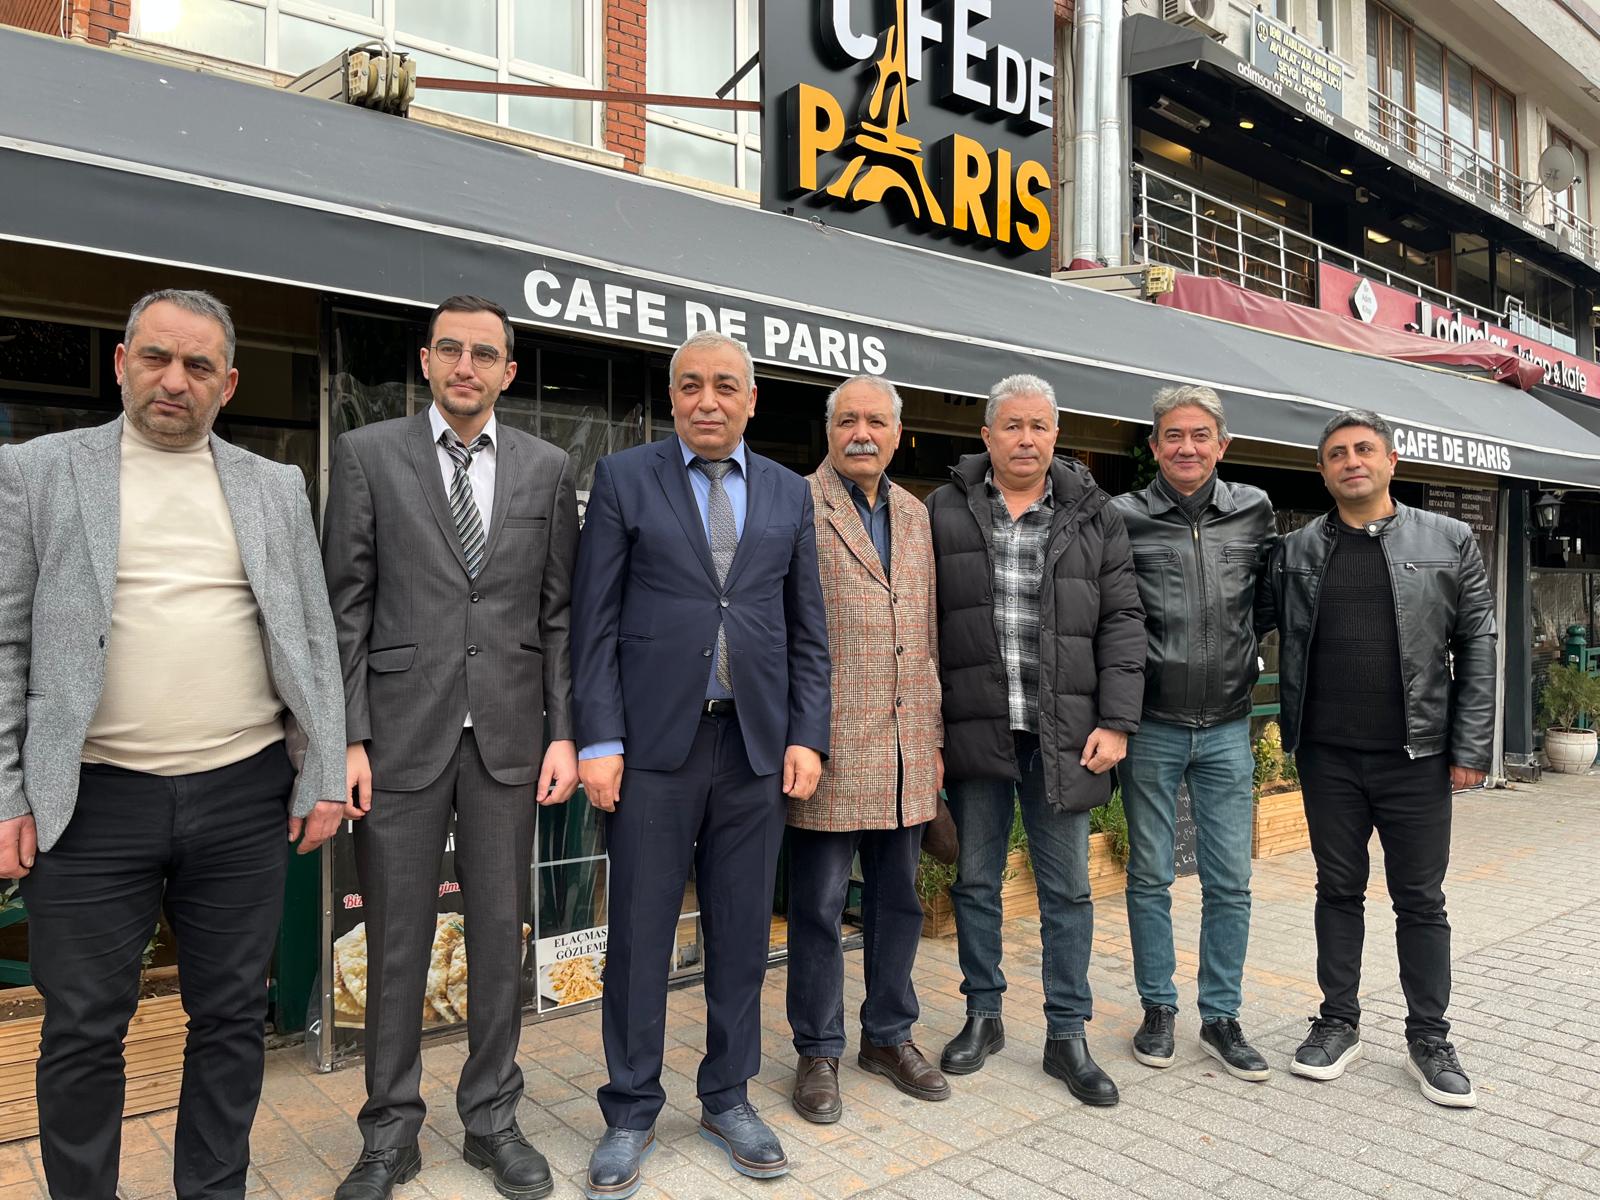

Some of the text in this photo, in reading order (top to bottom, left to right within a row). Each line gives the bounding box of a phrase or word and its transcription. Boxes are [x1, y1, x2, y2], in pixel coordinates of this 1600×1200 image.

[997, 44, 1054, 128] DE
[523, 269, 887, 375] CAFE DE PARIS
[1553, 362, 1562, 383] &
[1561, 360, 1587, 393] kafe
[1393, 428, 1512, 471] CAFE DE PARIS
[554, 938, 568, 948] EL
